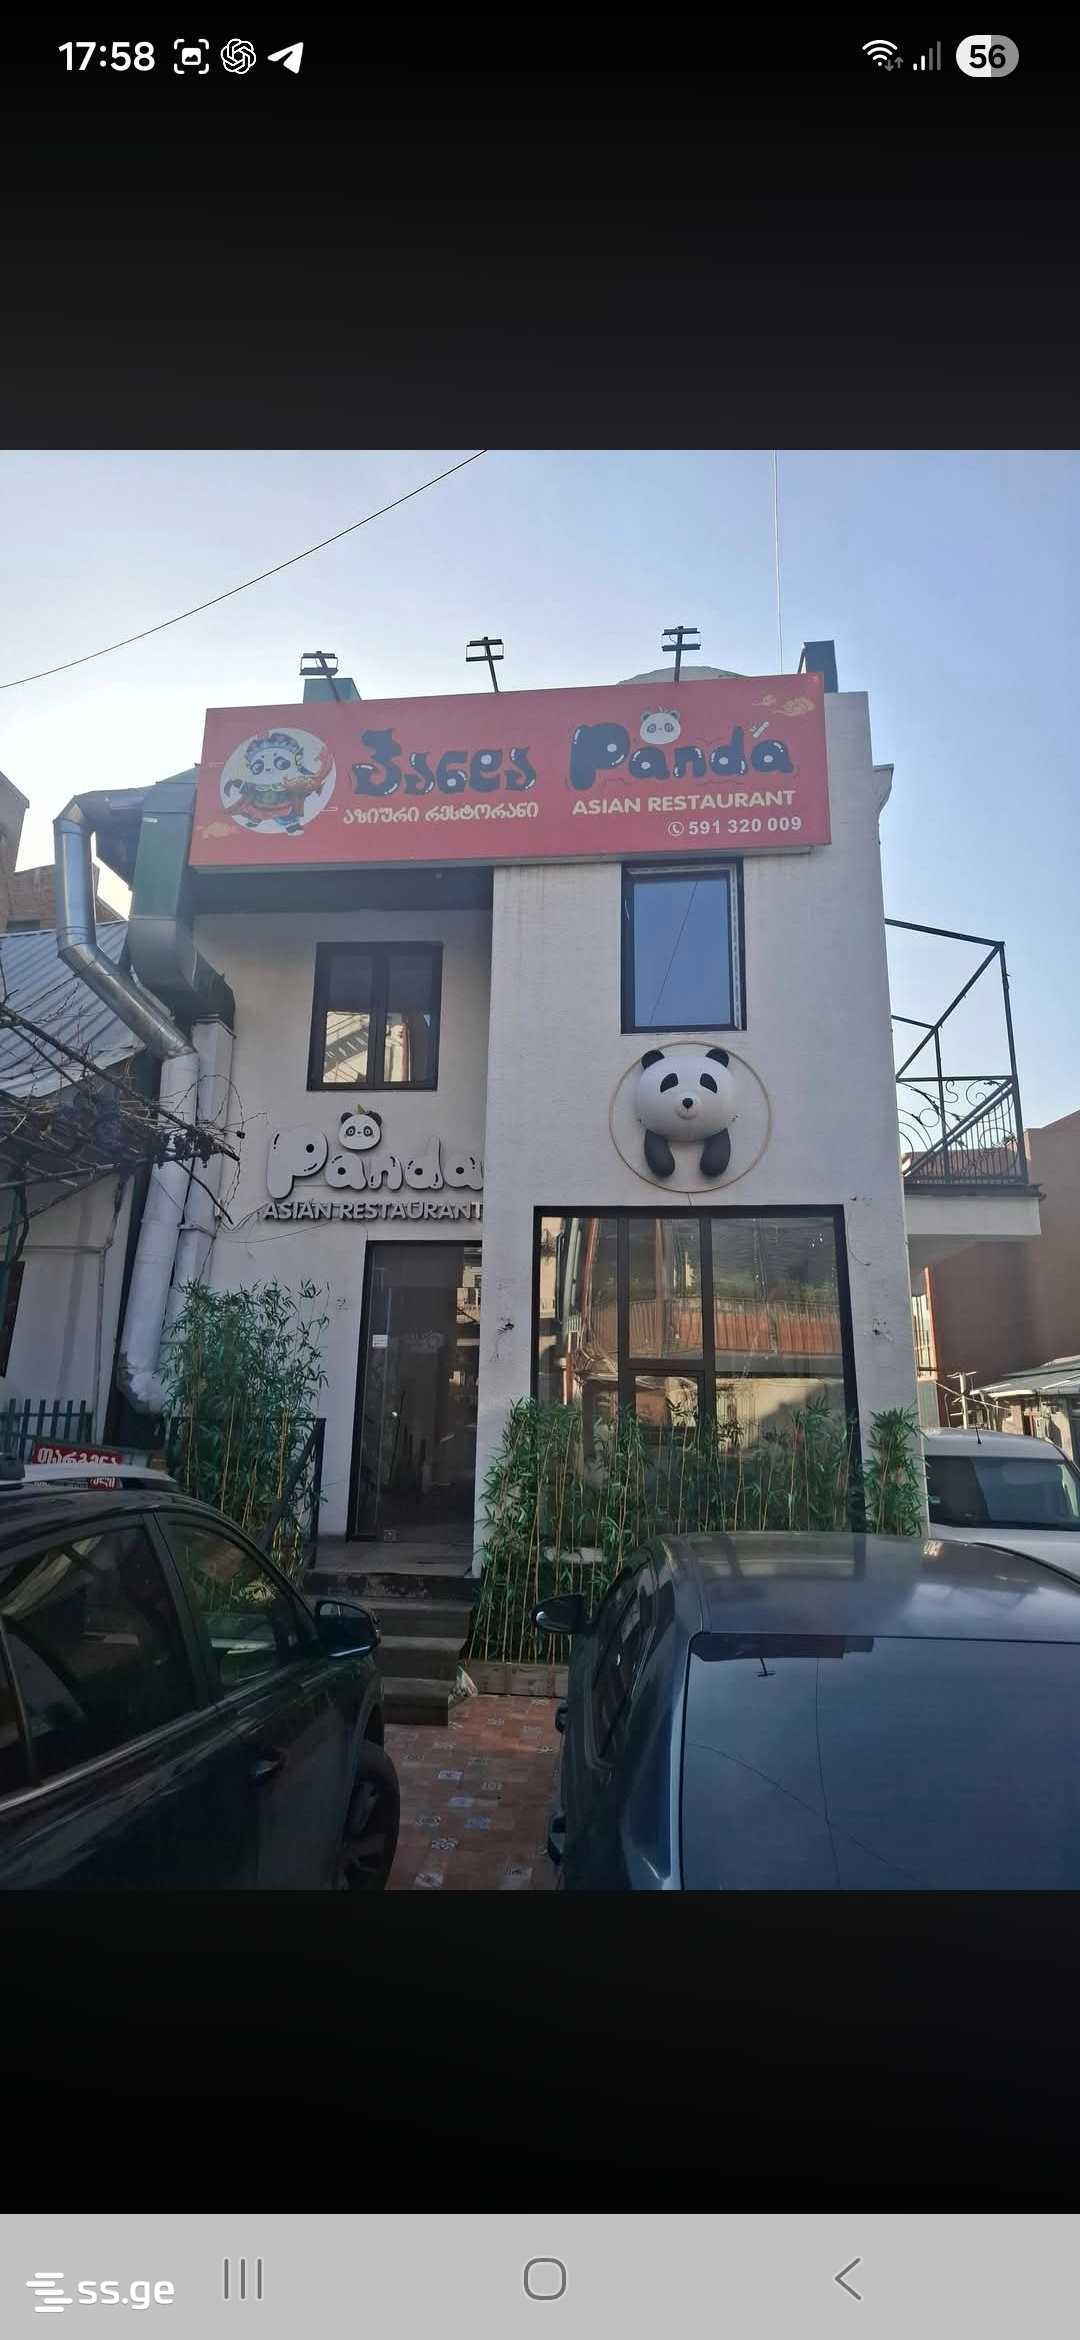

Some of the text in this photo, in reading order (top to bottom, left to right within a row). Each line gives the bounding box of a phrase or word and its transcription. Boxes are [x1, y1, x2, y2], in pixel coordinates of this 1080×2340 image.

[352, 728, 537, 796] პანდა
[569, 722, 794, 790] Panda
[343, 802, 539, 824] აზიური რესტორანი
[572, 790, 796, 815] ASIAN RESTAURANT
[688, 816, 802, 836] 591 320 009
[267, 1127, 484, 1200] Panda
[264, 1200, 483, 1221] ASIAN RESTAURANT
